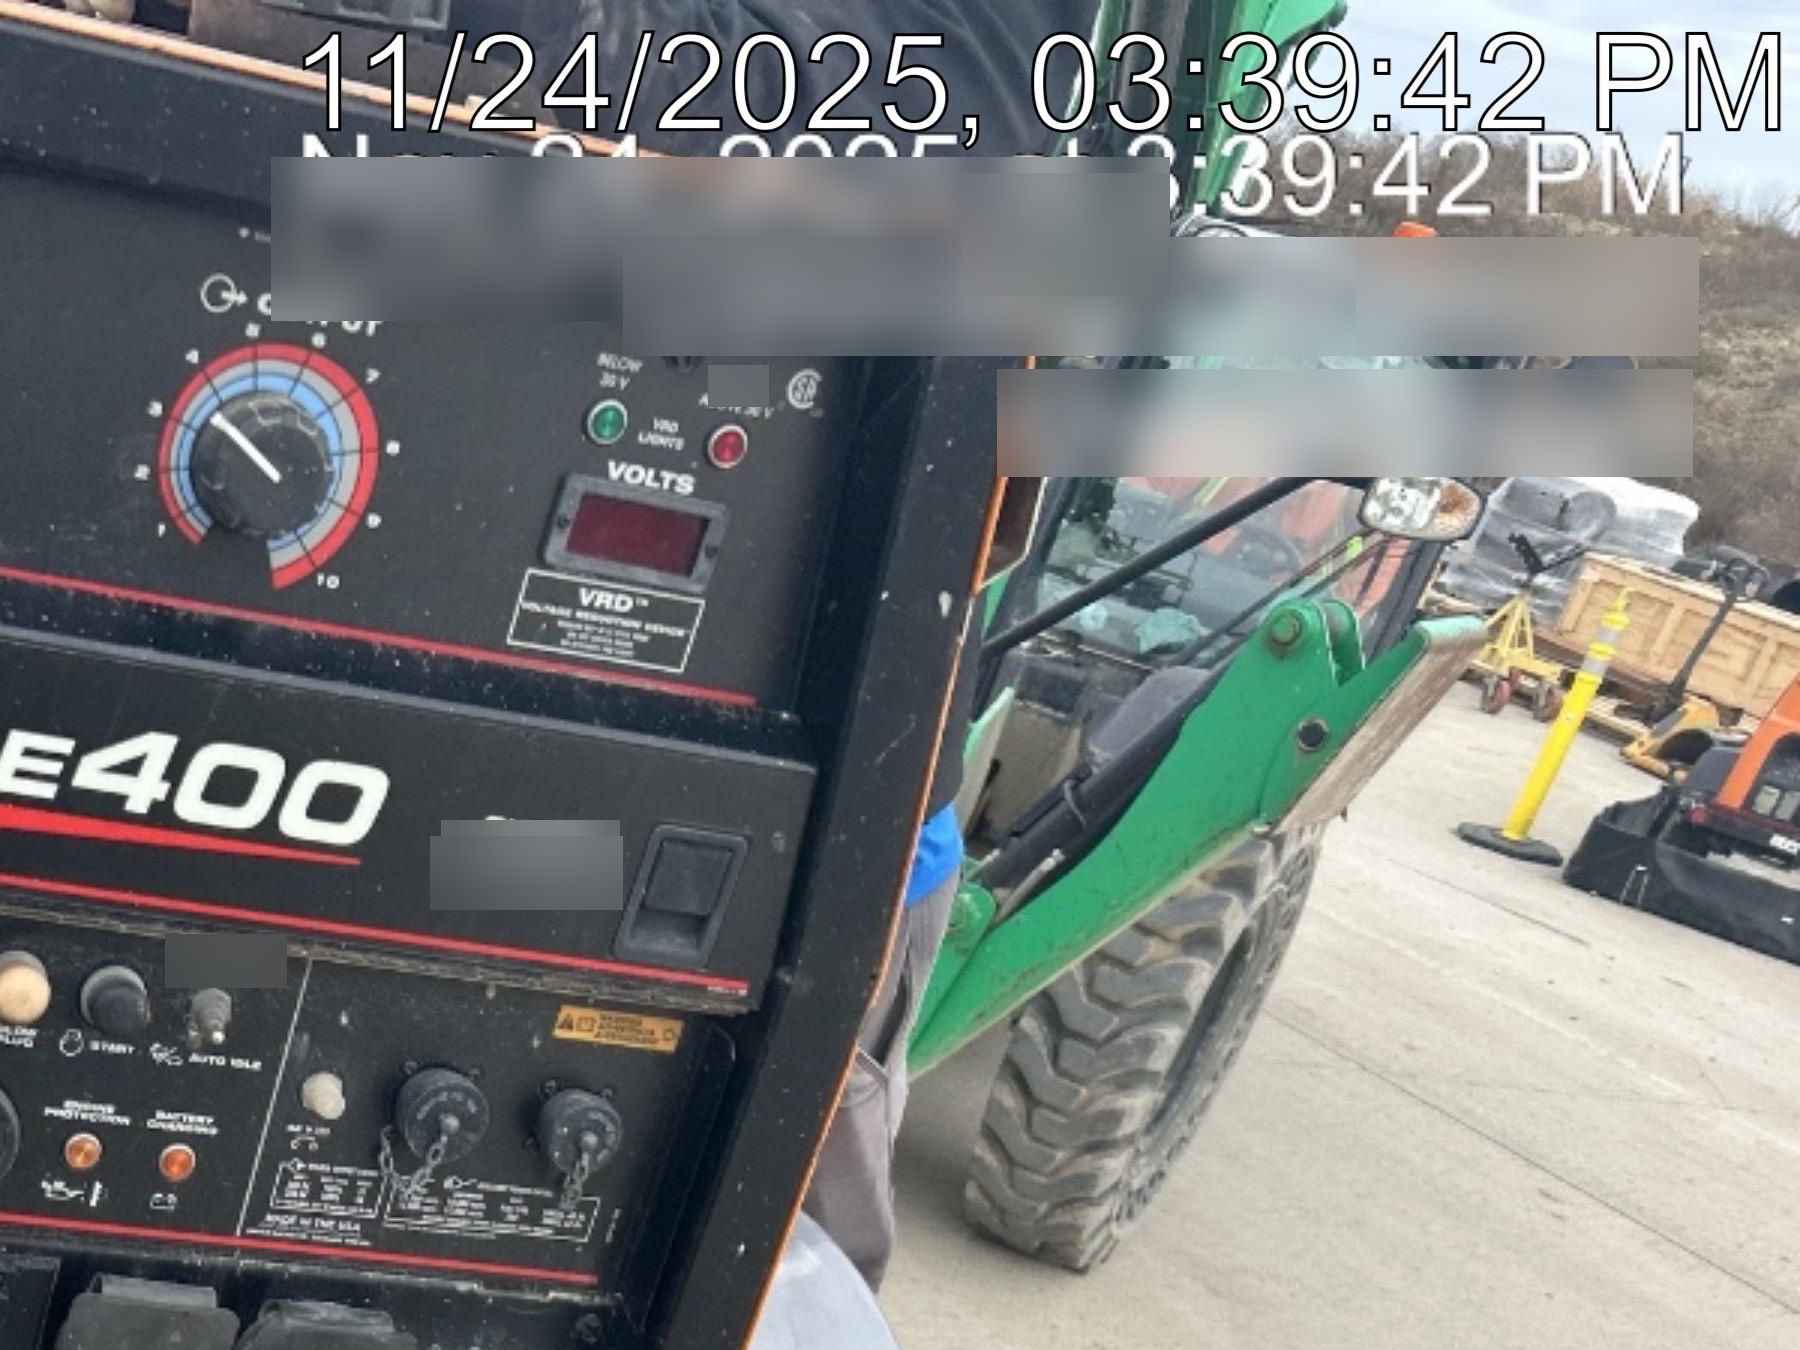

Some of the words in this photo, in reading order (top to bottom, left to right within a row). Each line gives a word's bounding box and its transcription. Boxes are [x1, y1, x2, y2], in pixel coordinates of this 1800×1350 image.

[607, 460, 696, 495] VOLTS
[317, 573, 340, 590] 10
[88, 1039, 136, 1055] START
[188, 1052, 227, 1067] AUTO
[230, 1057, 263, 1071] IDLE
